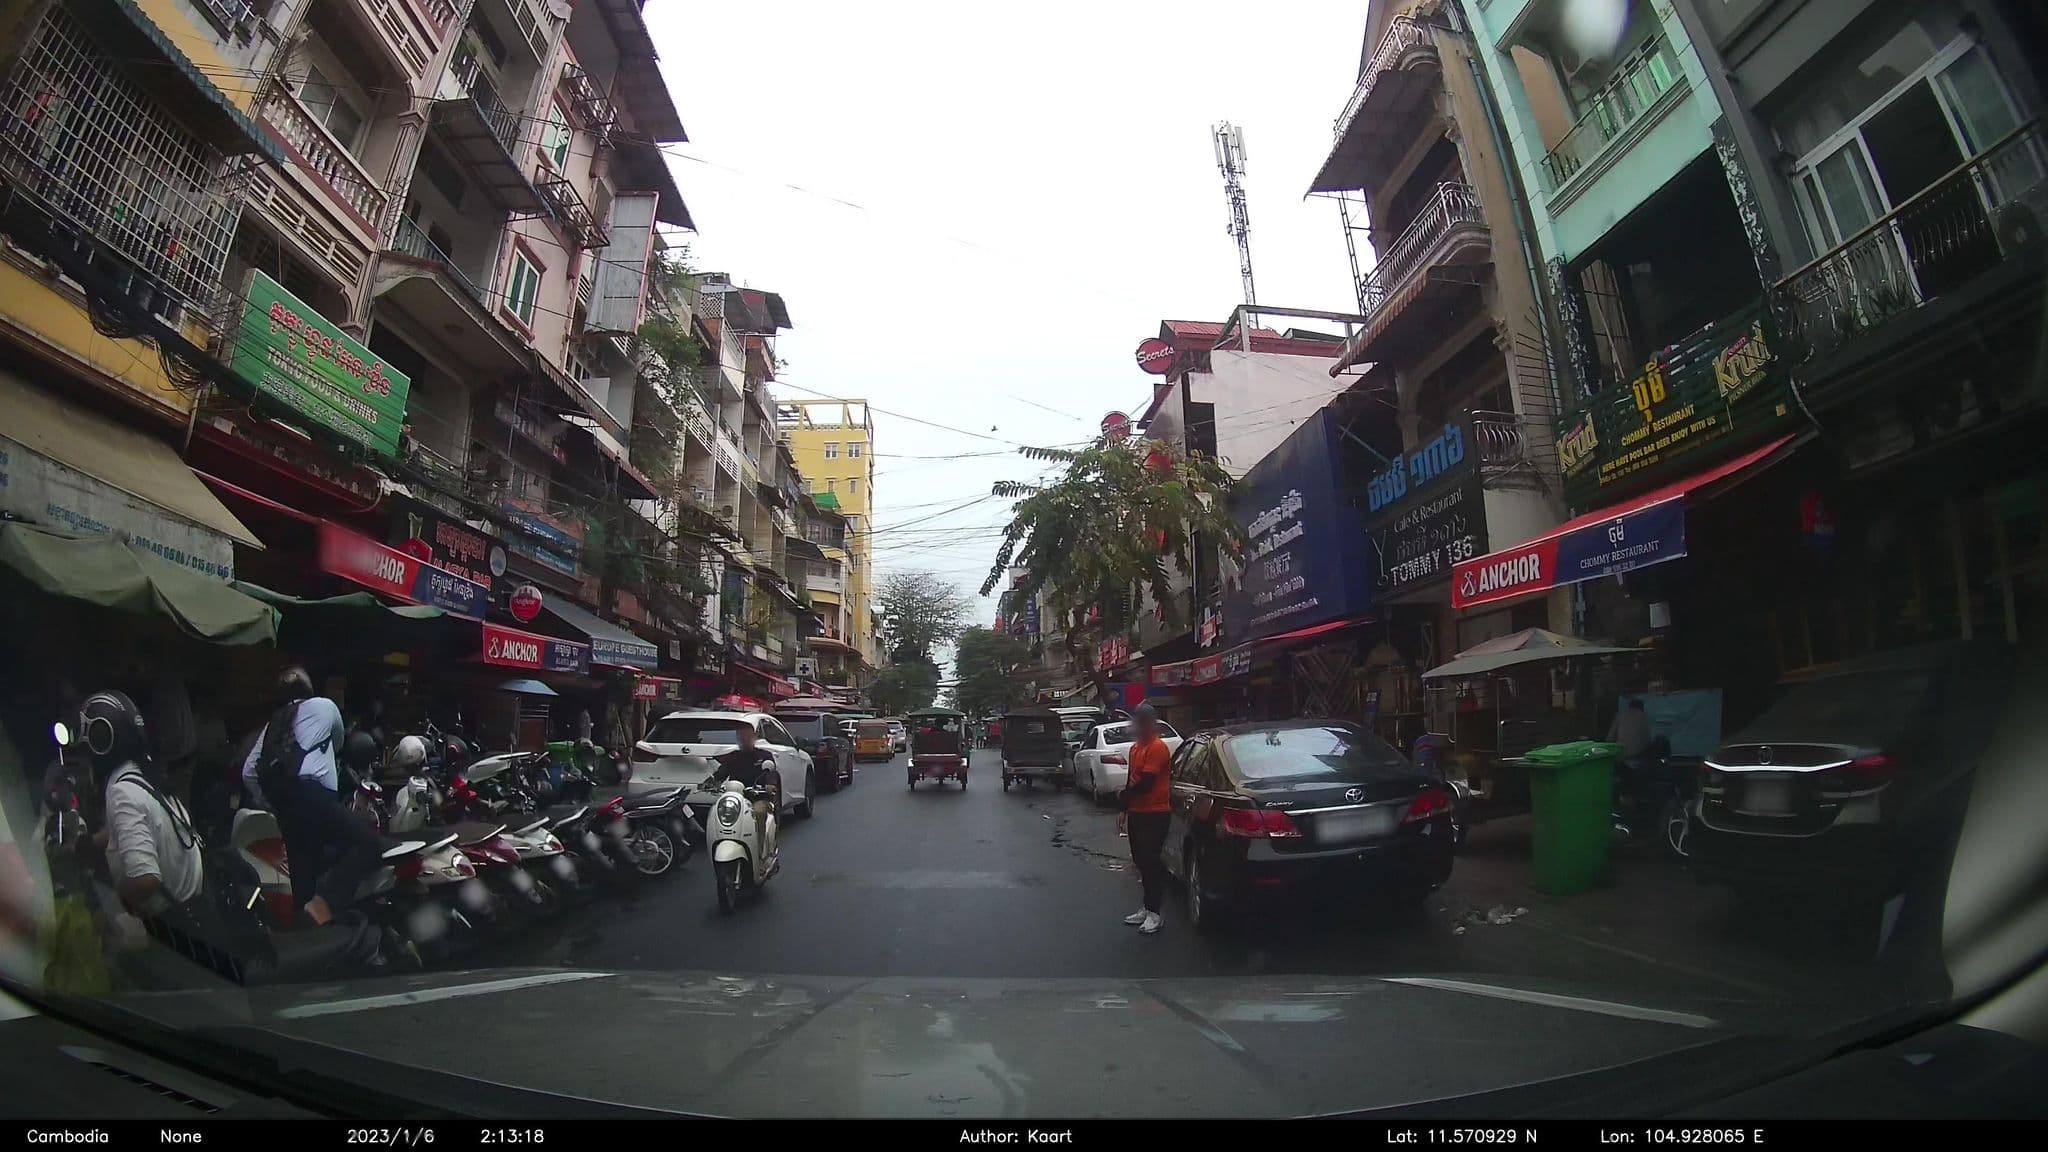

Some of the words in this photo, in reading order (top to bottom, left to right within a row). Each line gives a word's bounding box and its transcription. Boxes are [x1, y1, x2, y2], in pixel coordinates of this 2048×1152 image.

[1137, 346, 1175, 364] Secrets
[1712, 320, 1771, 398] Krud
[267, 346, 303, 382] TOKYO
[303, 371, 332, 398] FOOD
[343, 395, 378, 425] DRINKS
[1555, 413, 1599, 473] Krud
[1621, 425, 1650, 447] CHOMMY
[1652, 404, 1696, 434] RESTAURANT
[1411, 509, 1421, 524] &
[1420, 489, 1463, 521] Restaurant
[1390, 548, 1441, 586] TOMMY
[1446, 535, 1473, 565] 136
[1479, 553, 1541, 593] ANCHOR
[1580, 552, 1611, 569] CHOMMY
[1611, 540, 1660, 562] RESTAURANT
[502, 639, 538, 663] ANCHOR
